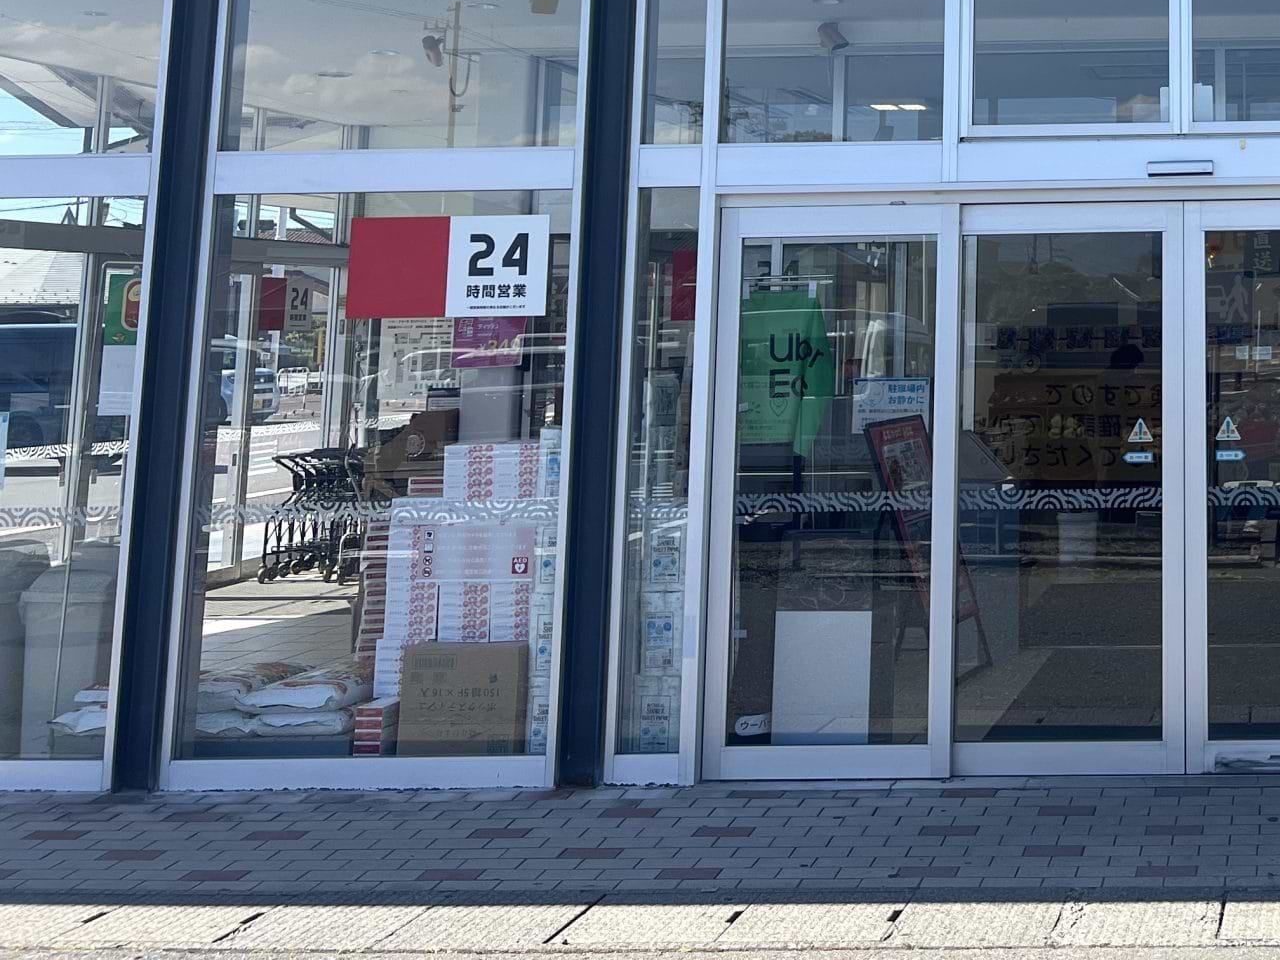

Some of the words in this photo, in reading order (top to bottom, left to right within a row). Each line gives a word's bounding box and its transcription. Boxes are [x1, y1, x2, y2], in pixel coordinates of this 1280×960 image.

[468, 233, 529, 276] 24
[291, 288, 308, 310] 24
[466, 284, 527, 298] 時間営業
[888, 396, 925, 404] お静かに
